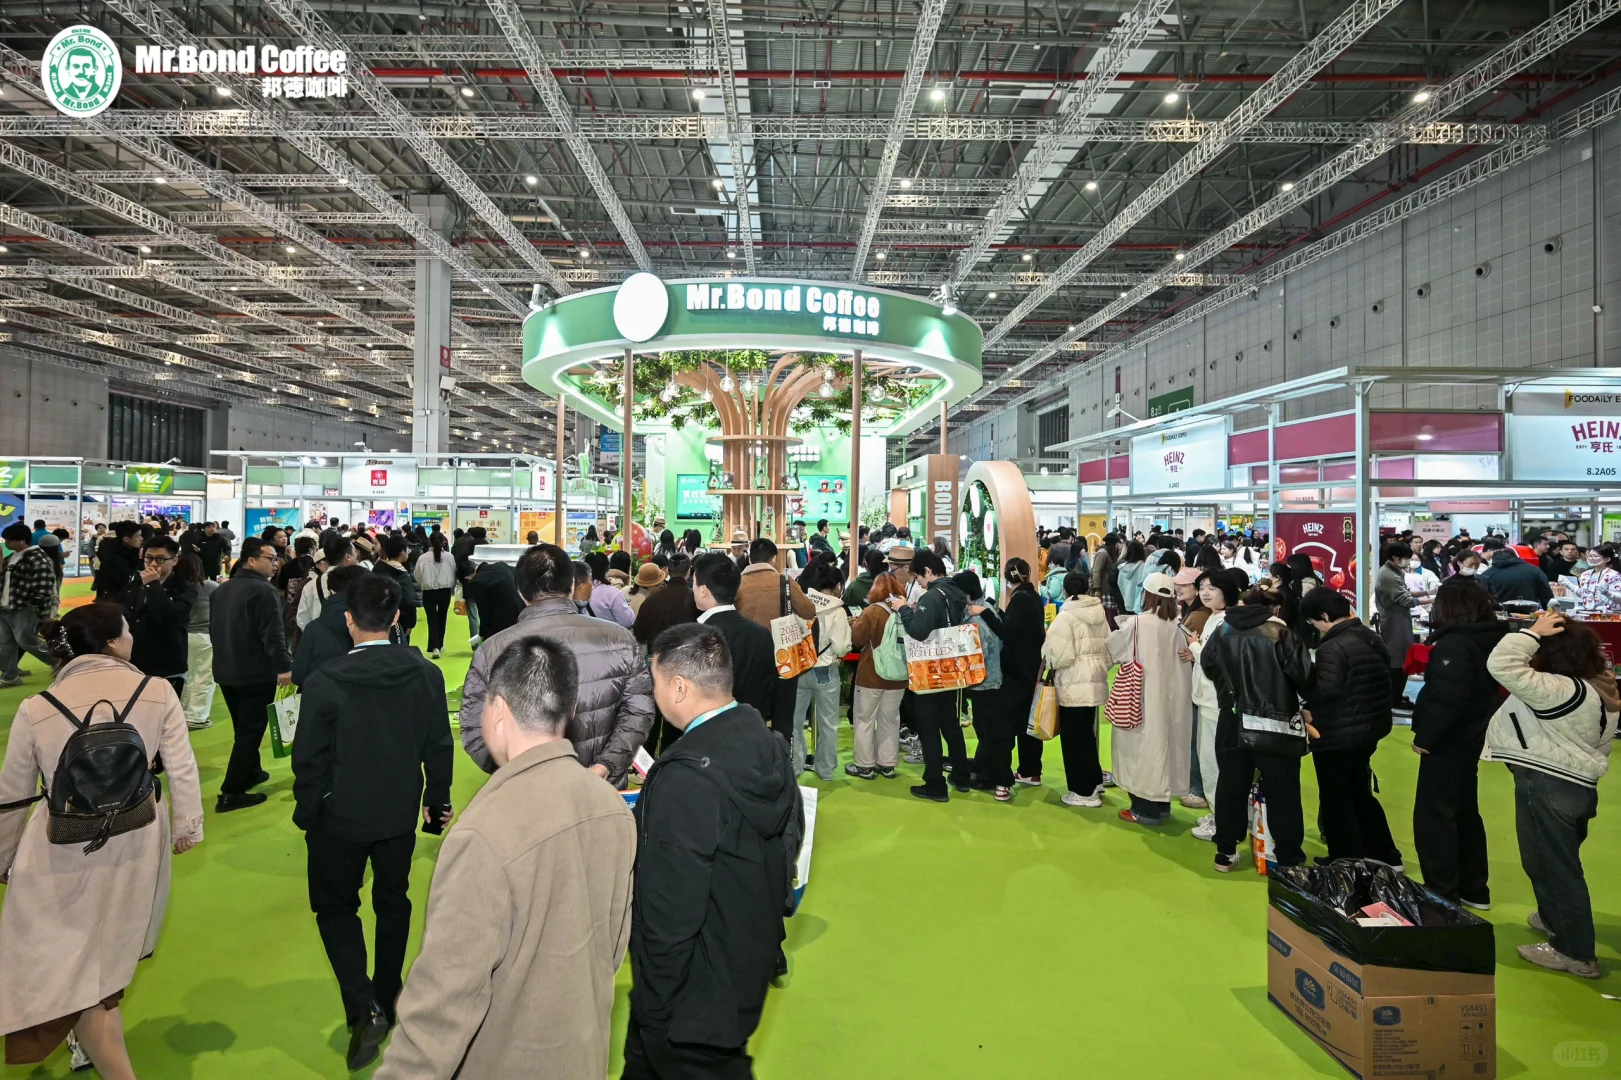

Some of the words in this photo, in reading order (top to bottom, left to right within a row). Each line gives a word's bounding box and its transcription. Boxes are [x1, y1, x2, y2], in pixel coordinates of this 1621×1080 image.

[686, 283, 801, 312] Mr.Bond
[806, 286, 880, 318] Coffee
[1571, 420, 1621, 442] HEIN
[1590, 441, 1613, 453] 亨氏
[1163, 451, 1185, 466] HEINZ
[1586, 467, 1616, 476] 8.2A05
[934, 480, 952, 526] BOND
[1302, 522, 1324, 535] HEINZ
[780, 623, 798, 636] 2025
[908, 640, 932, 651] 2025
